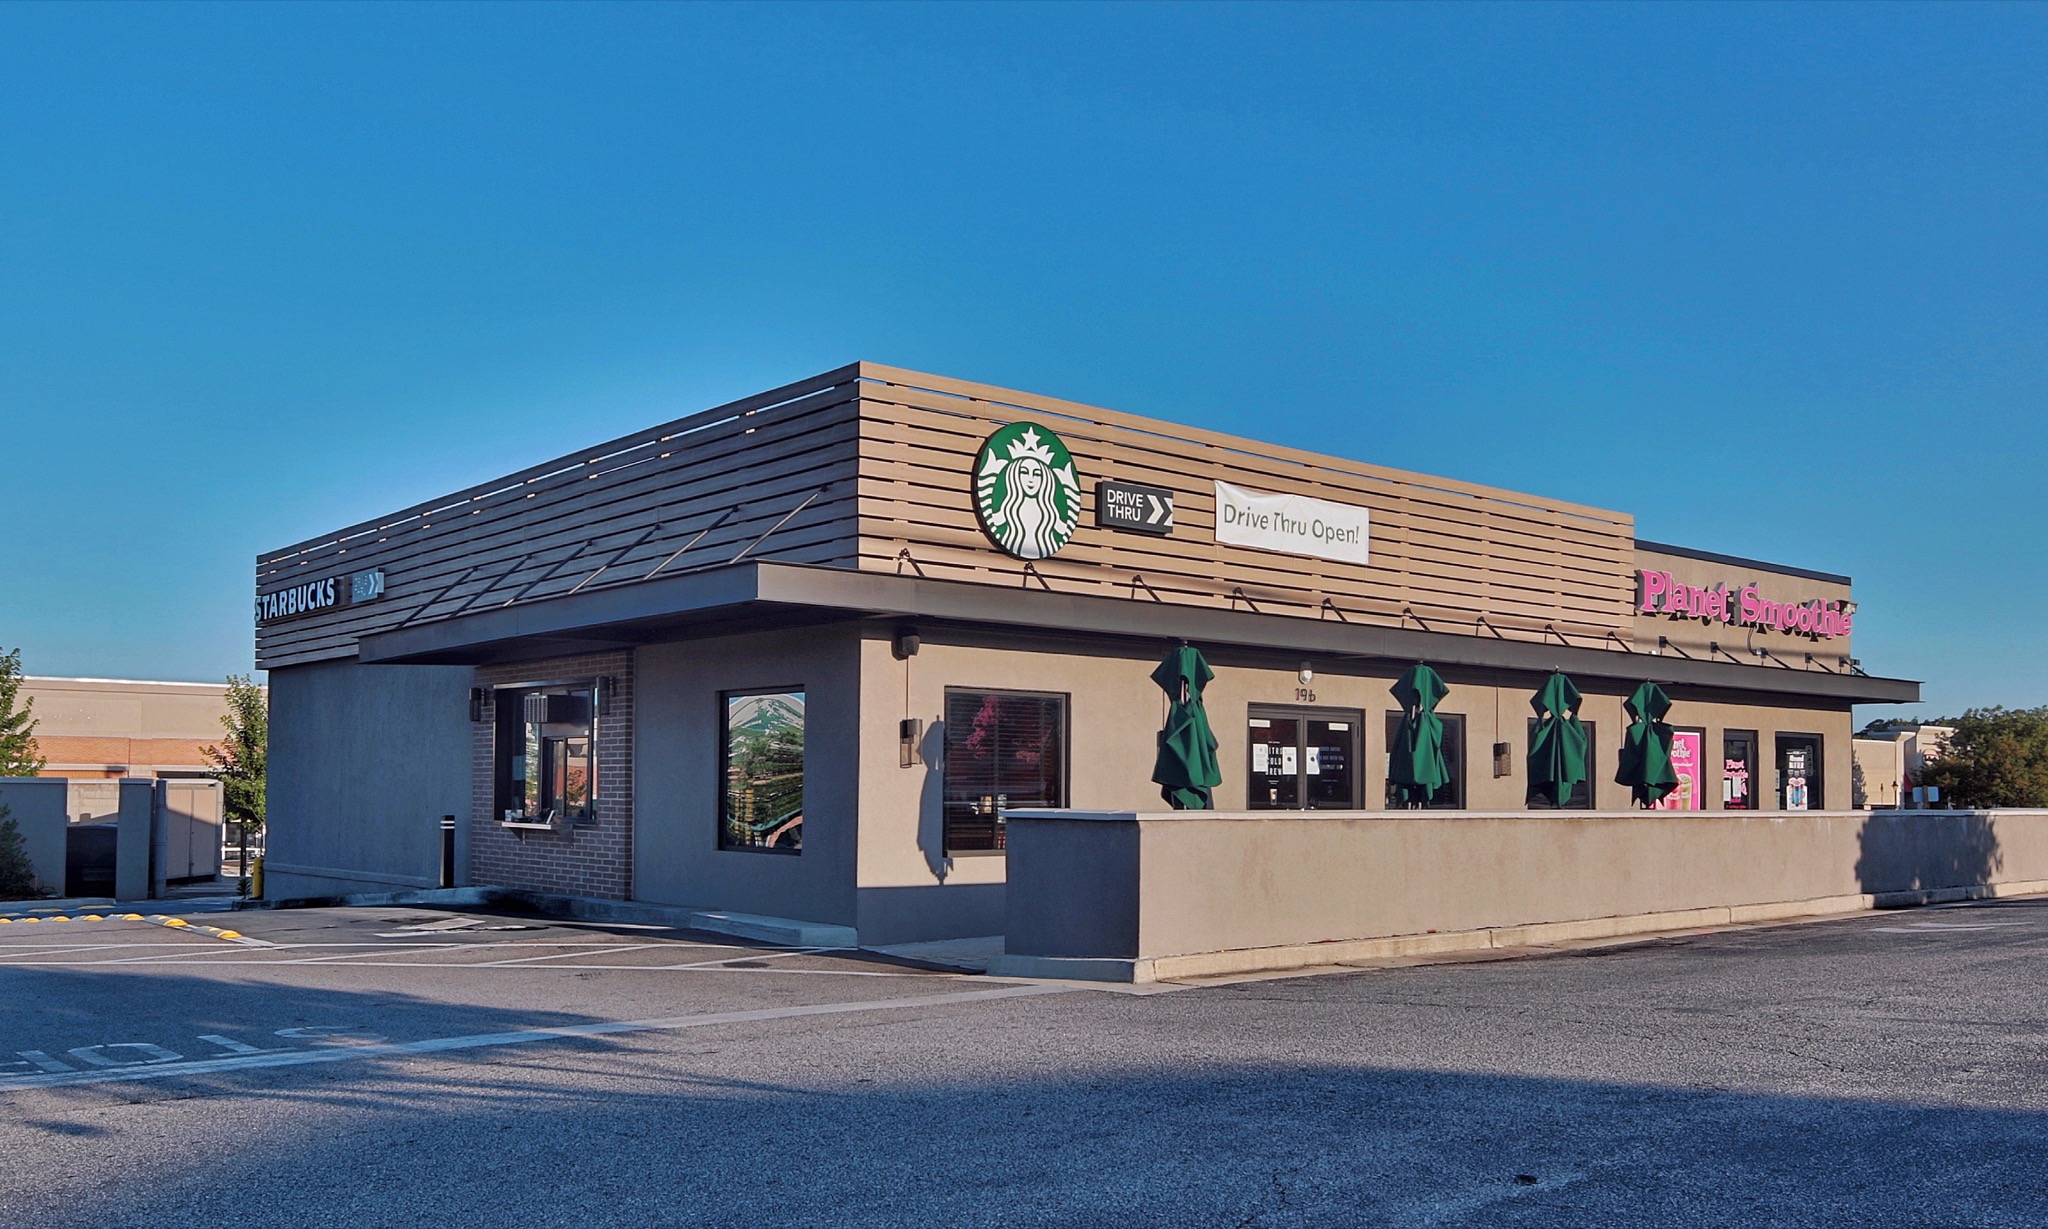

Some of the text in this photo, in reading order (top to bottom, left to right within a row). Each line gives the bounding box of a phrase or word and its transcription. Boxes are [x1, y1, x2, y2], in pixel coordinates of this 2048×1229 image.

[1107, 489, 1143, 508] DRIVE
[1107, 504, 1141, 521] THRU
[1224, 504, 1360, 545] Drive Thru Open!
[255, 577, 334, 622] STARBUCKS
[1640, 568, 1853, 639] Planet Smoothie
[1295, 688, 1316, 702] 196
